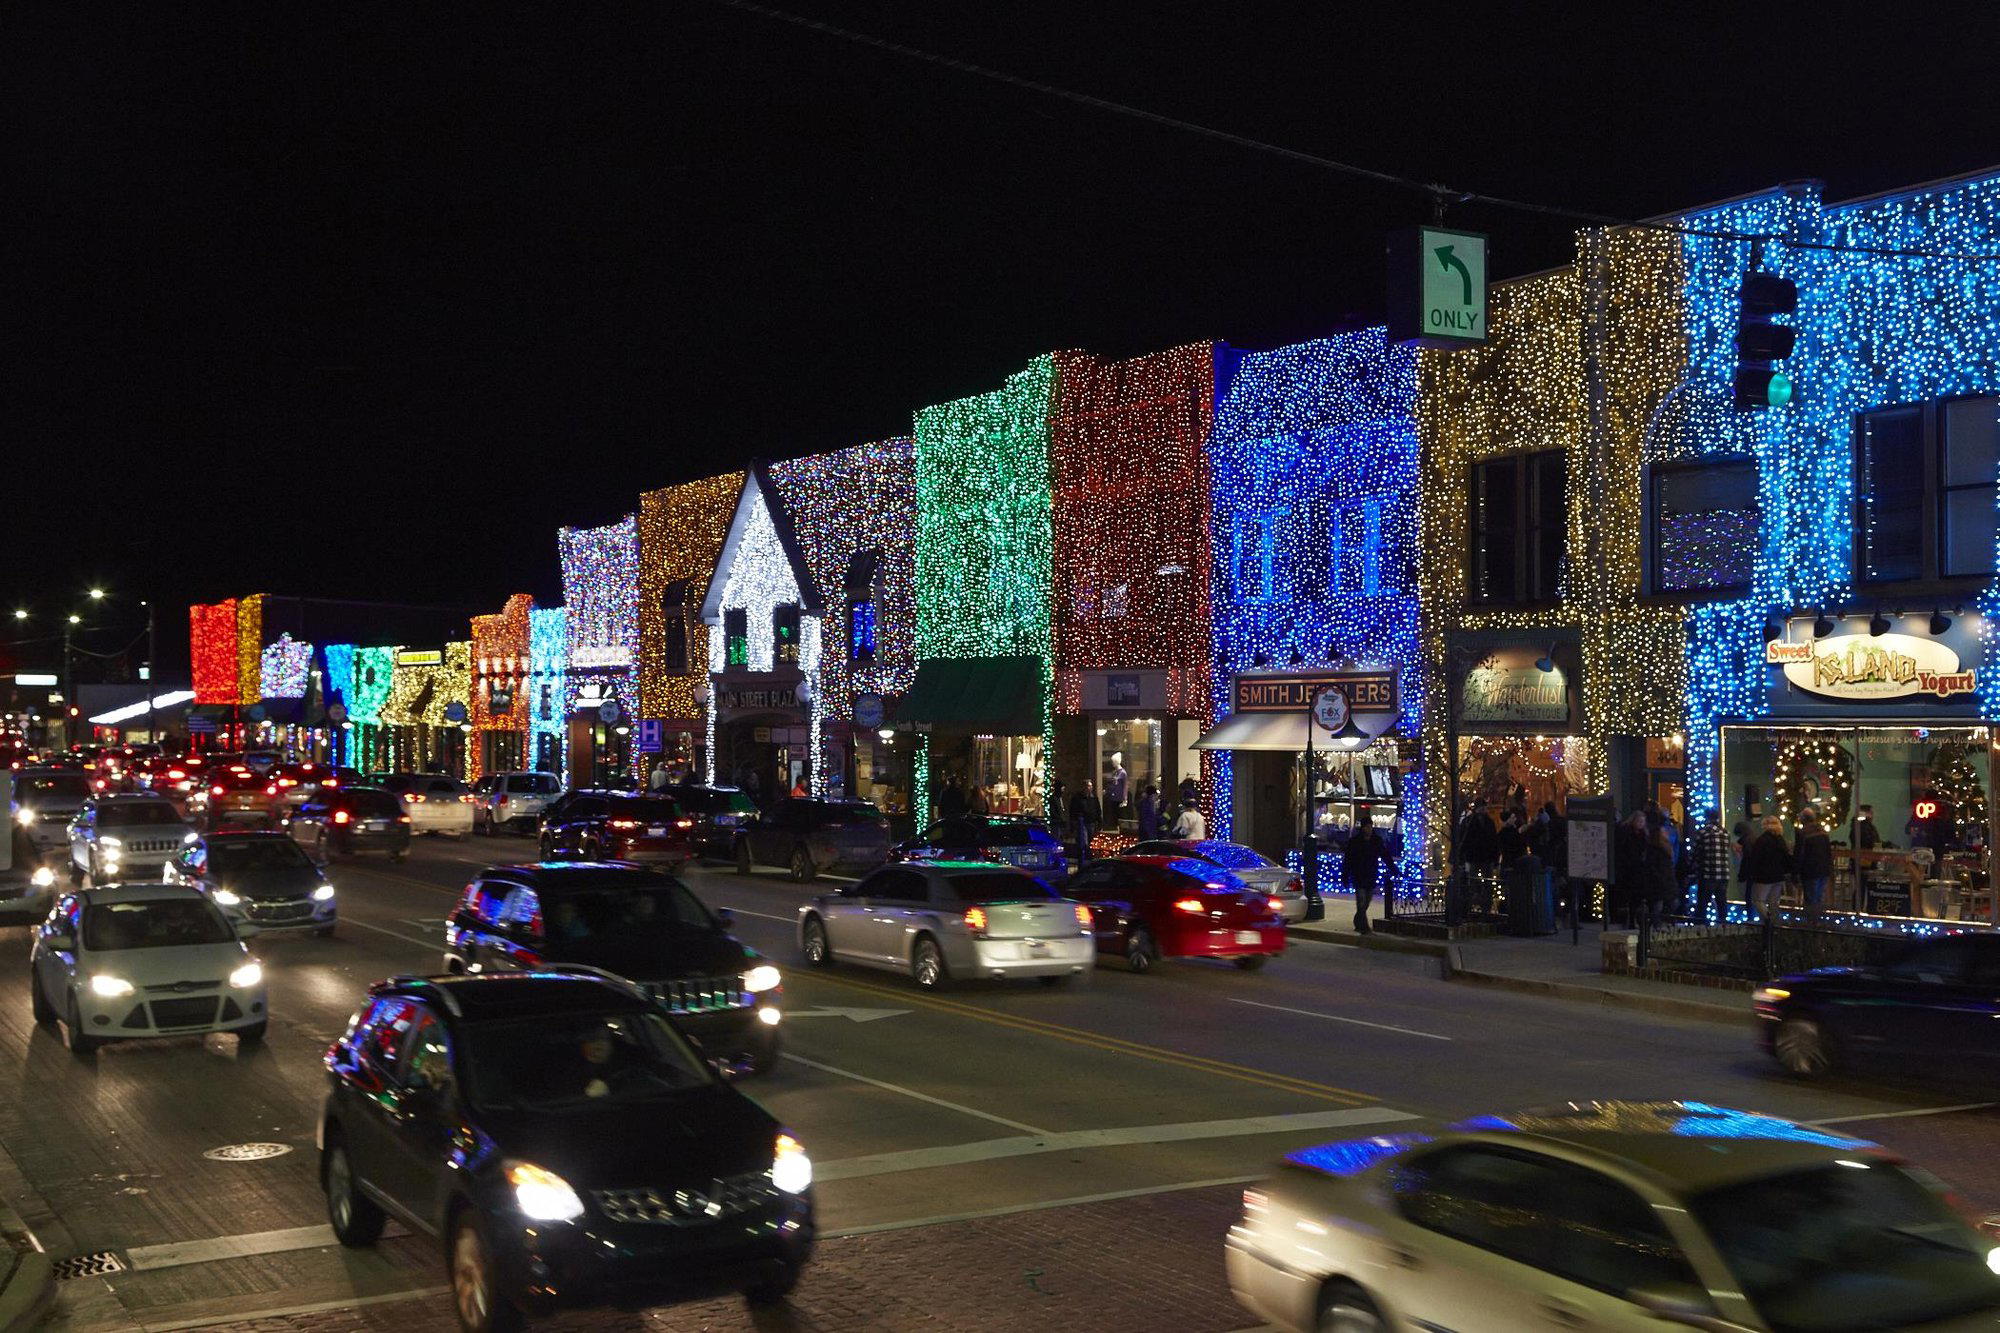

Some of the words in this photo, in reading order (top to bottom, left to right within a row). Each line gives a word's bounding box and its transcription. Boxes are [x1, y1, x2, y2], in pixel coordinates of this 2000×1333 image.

[1431, 309, 1478, 330] ONLY
[1769, 643, 1811, 660] Sweet
[1813, 650, 1917, 687] ISLAND
[1239, 686, 1289, 704] SMITH
[1295, 683, 1391, 703] JEERS
[1480, 673, 1564, 706] Wanderlust
[1917, 672, 1975, 694] Yogurt
[641, 720, 661, 742] H
[1657, 751, 1678, 764] 404
